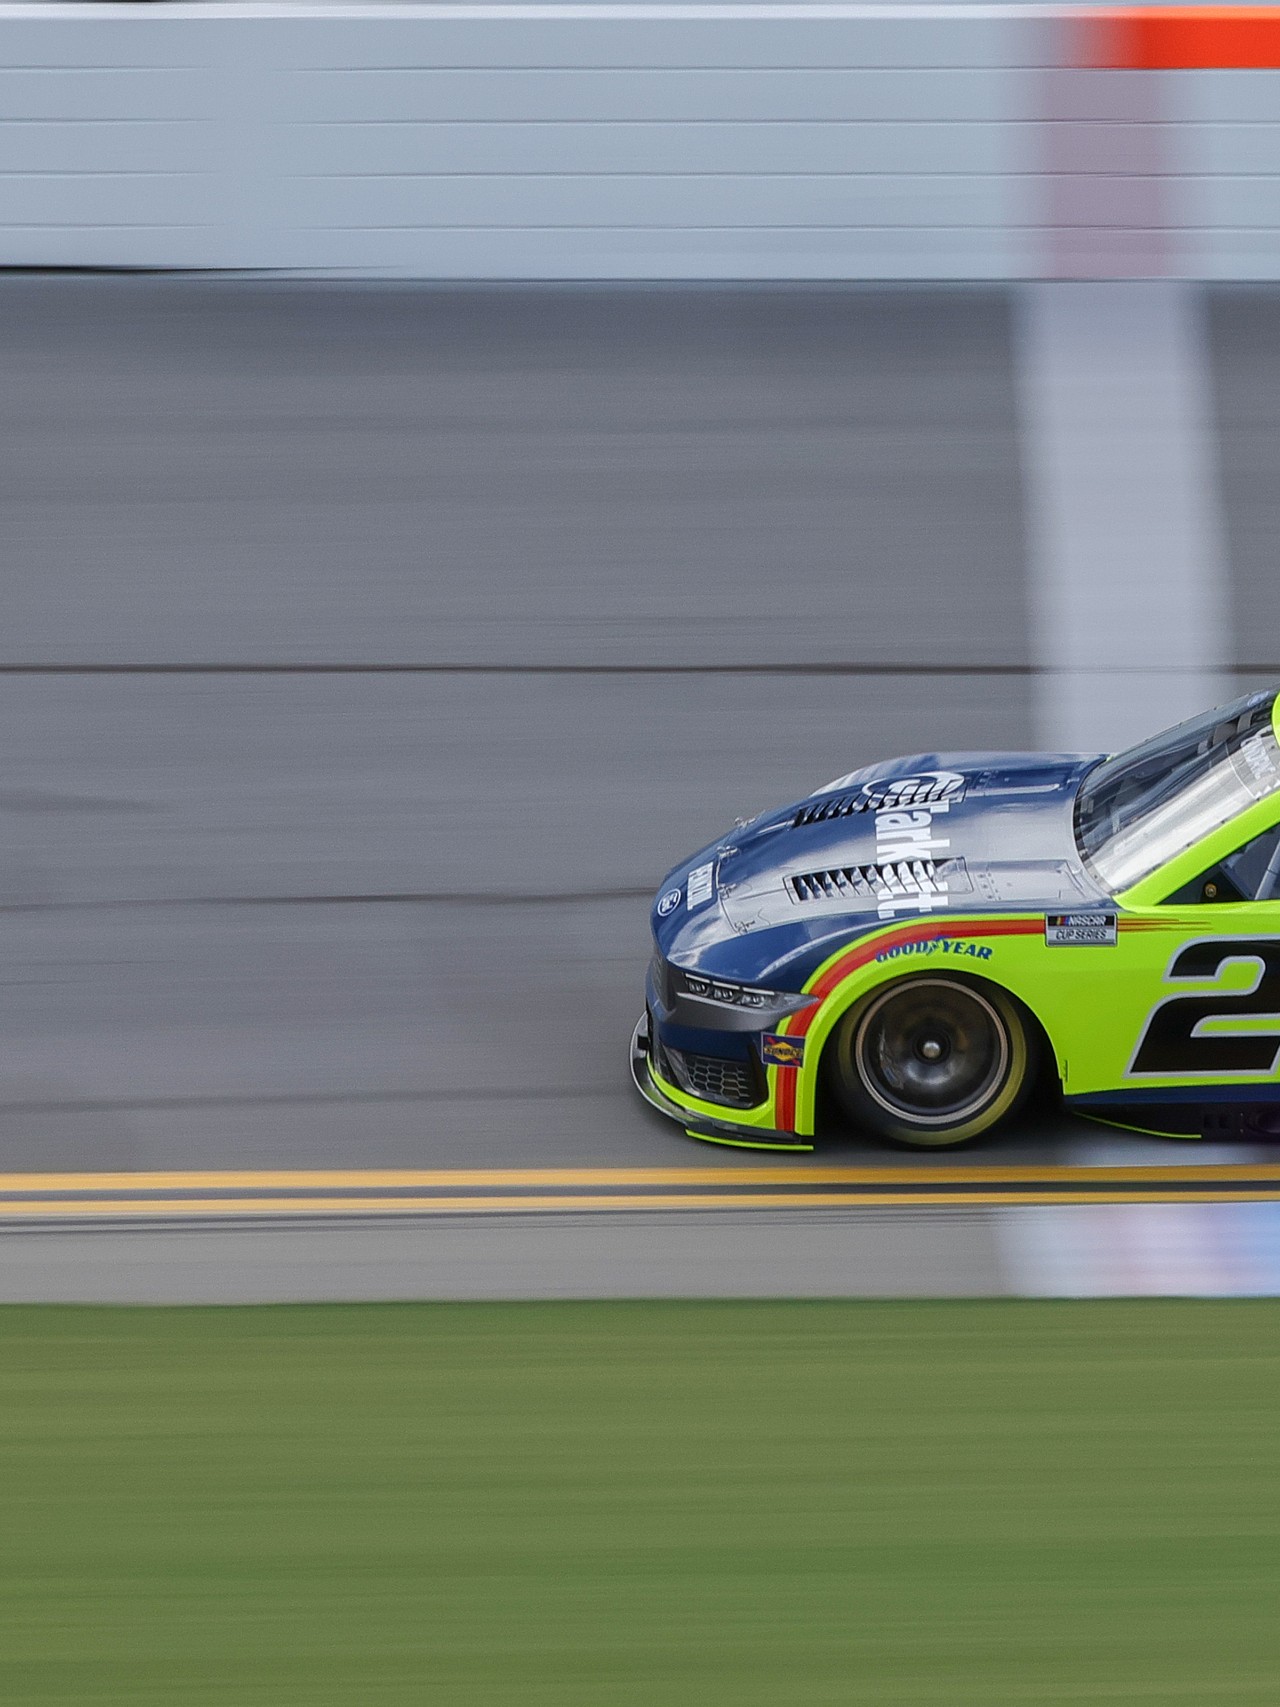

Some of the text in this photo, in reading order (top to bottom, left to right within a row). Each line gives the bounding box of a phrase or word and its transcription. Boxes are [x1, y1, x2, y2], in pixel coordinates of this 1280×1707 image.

[1068, 915, 1106, 926] NASCAR
[1056, 929, 1107, 940] CUP SERIES
